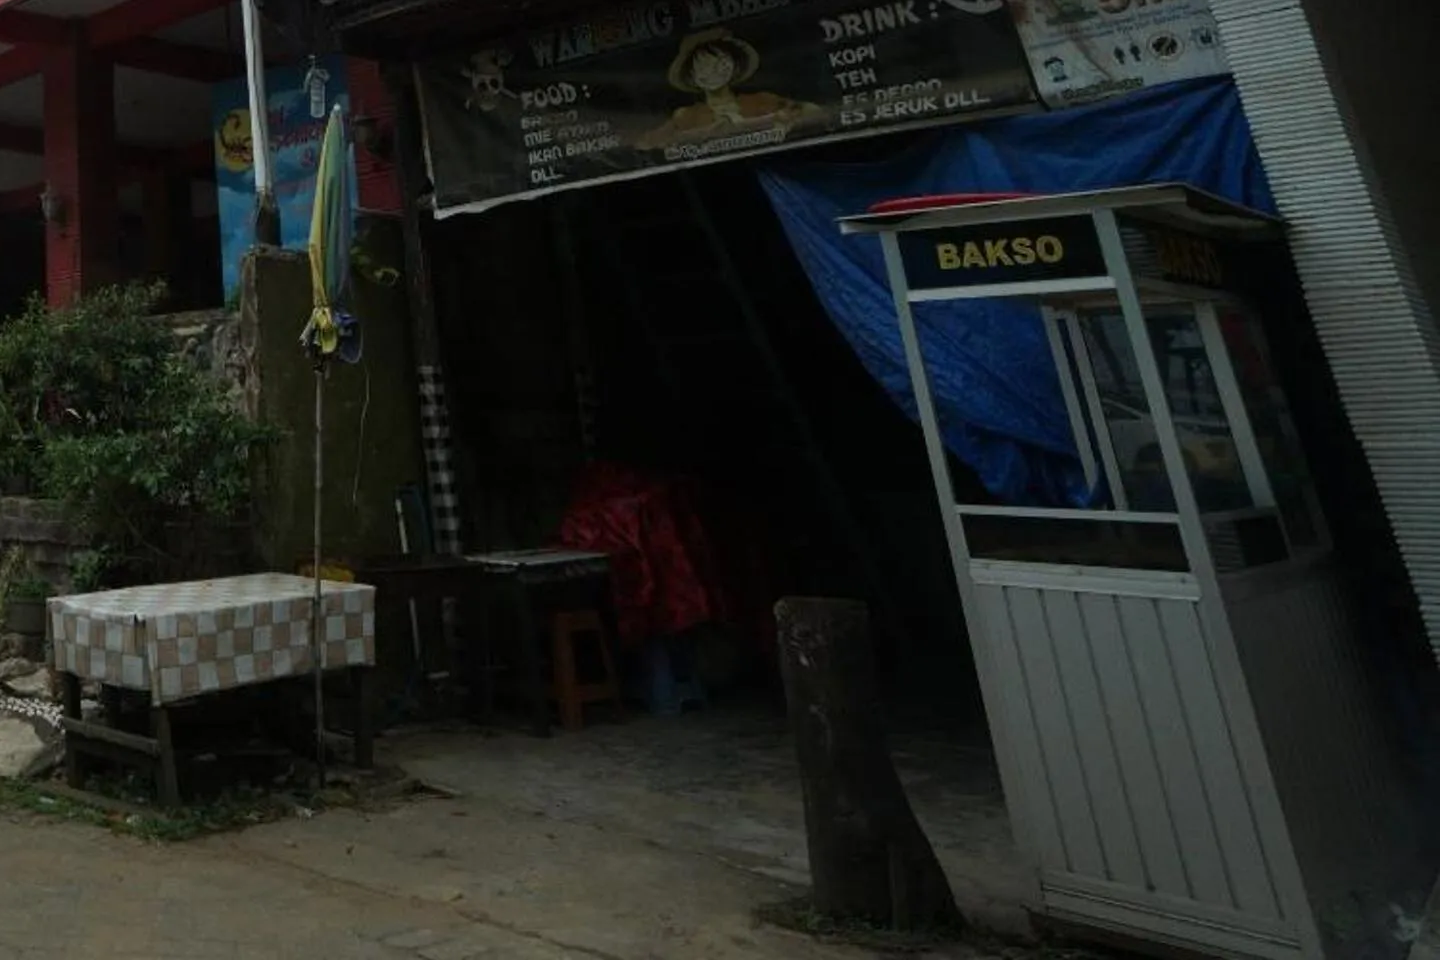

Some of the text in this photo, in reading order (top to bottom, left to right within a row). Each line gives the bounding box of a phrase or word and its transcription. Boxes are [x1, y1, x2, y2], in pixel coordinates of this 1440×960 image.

[829, 44, 876, 68] KOPI
[834, 67, 878, 90] TEH
[840, 109, 867, 126] ES
[871, 94, 939, 121] JERUK
[523, 130, 554, 148] MIE
[935, 234, 1065, 271] BAKSO
